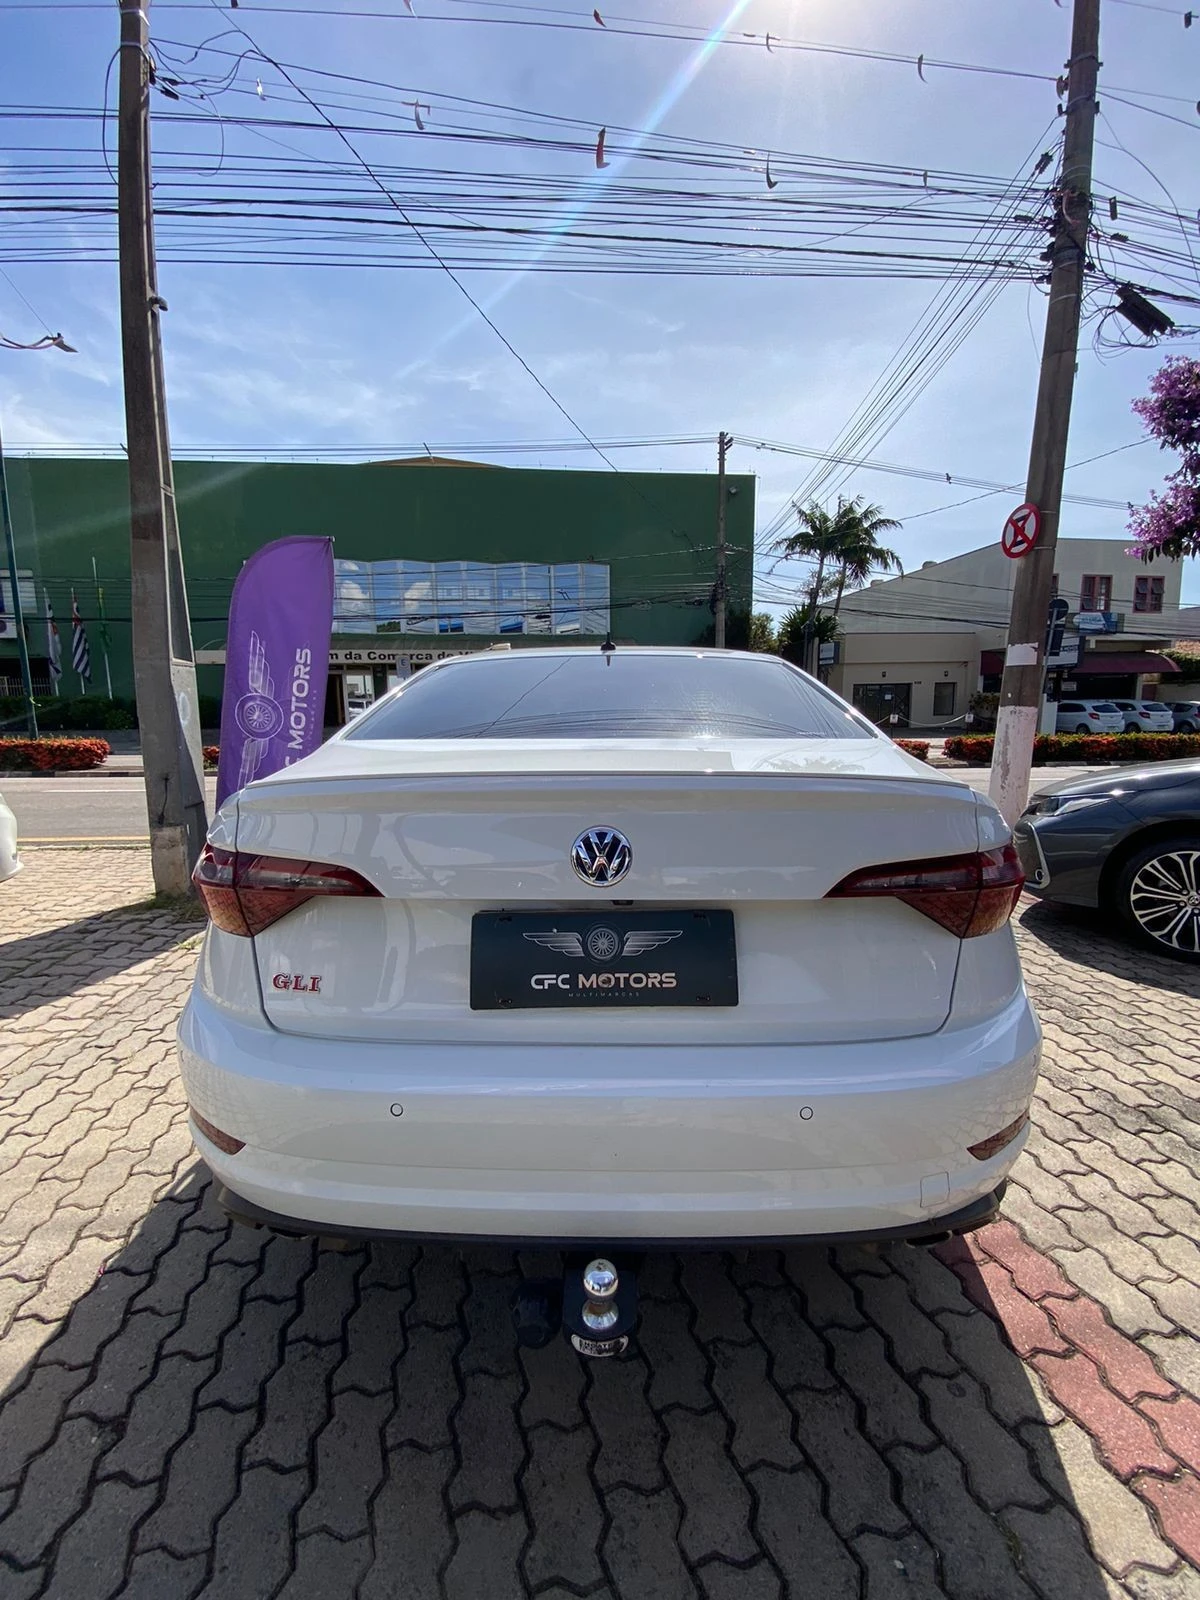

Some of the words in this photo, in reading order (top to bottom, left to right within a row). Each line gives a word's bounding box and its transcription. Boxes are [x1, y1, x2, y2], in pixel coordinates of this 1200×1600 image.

[344, 651, 362, 660] da
[367, 651, 433, 660] Comrca
[287, 648, 311, 750] MOTORS
[272, 973, 321, 993] GLI
[530, 974, 570, 989] CFC
[578, 972, 677, 989] MOTORS
